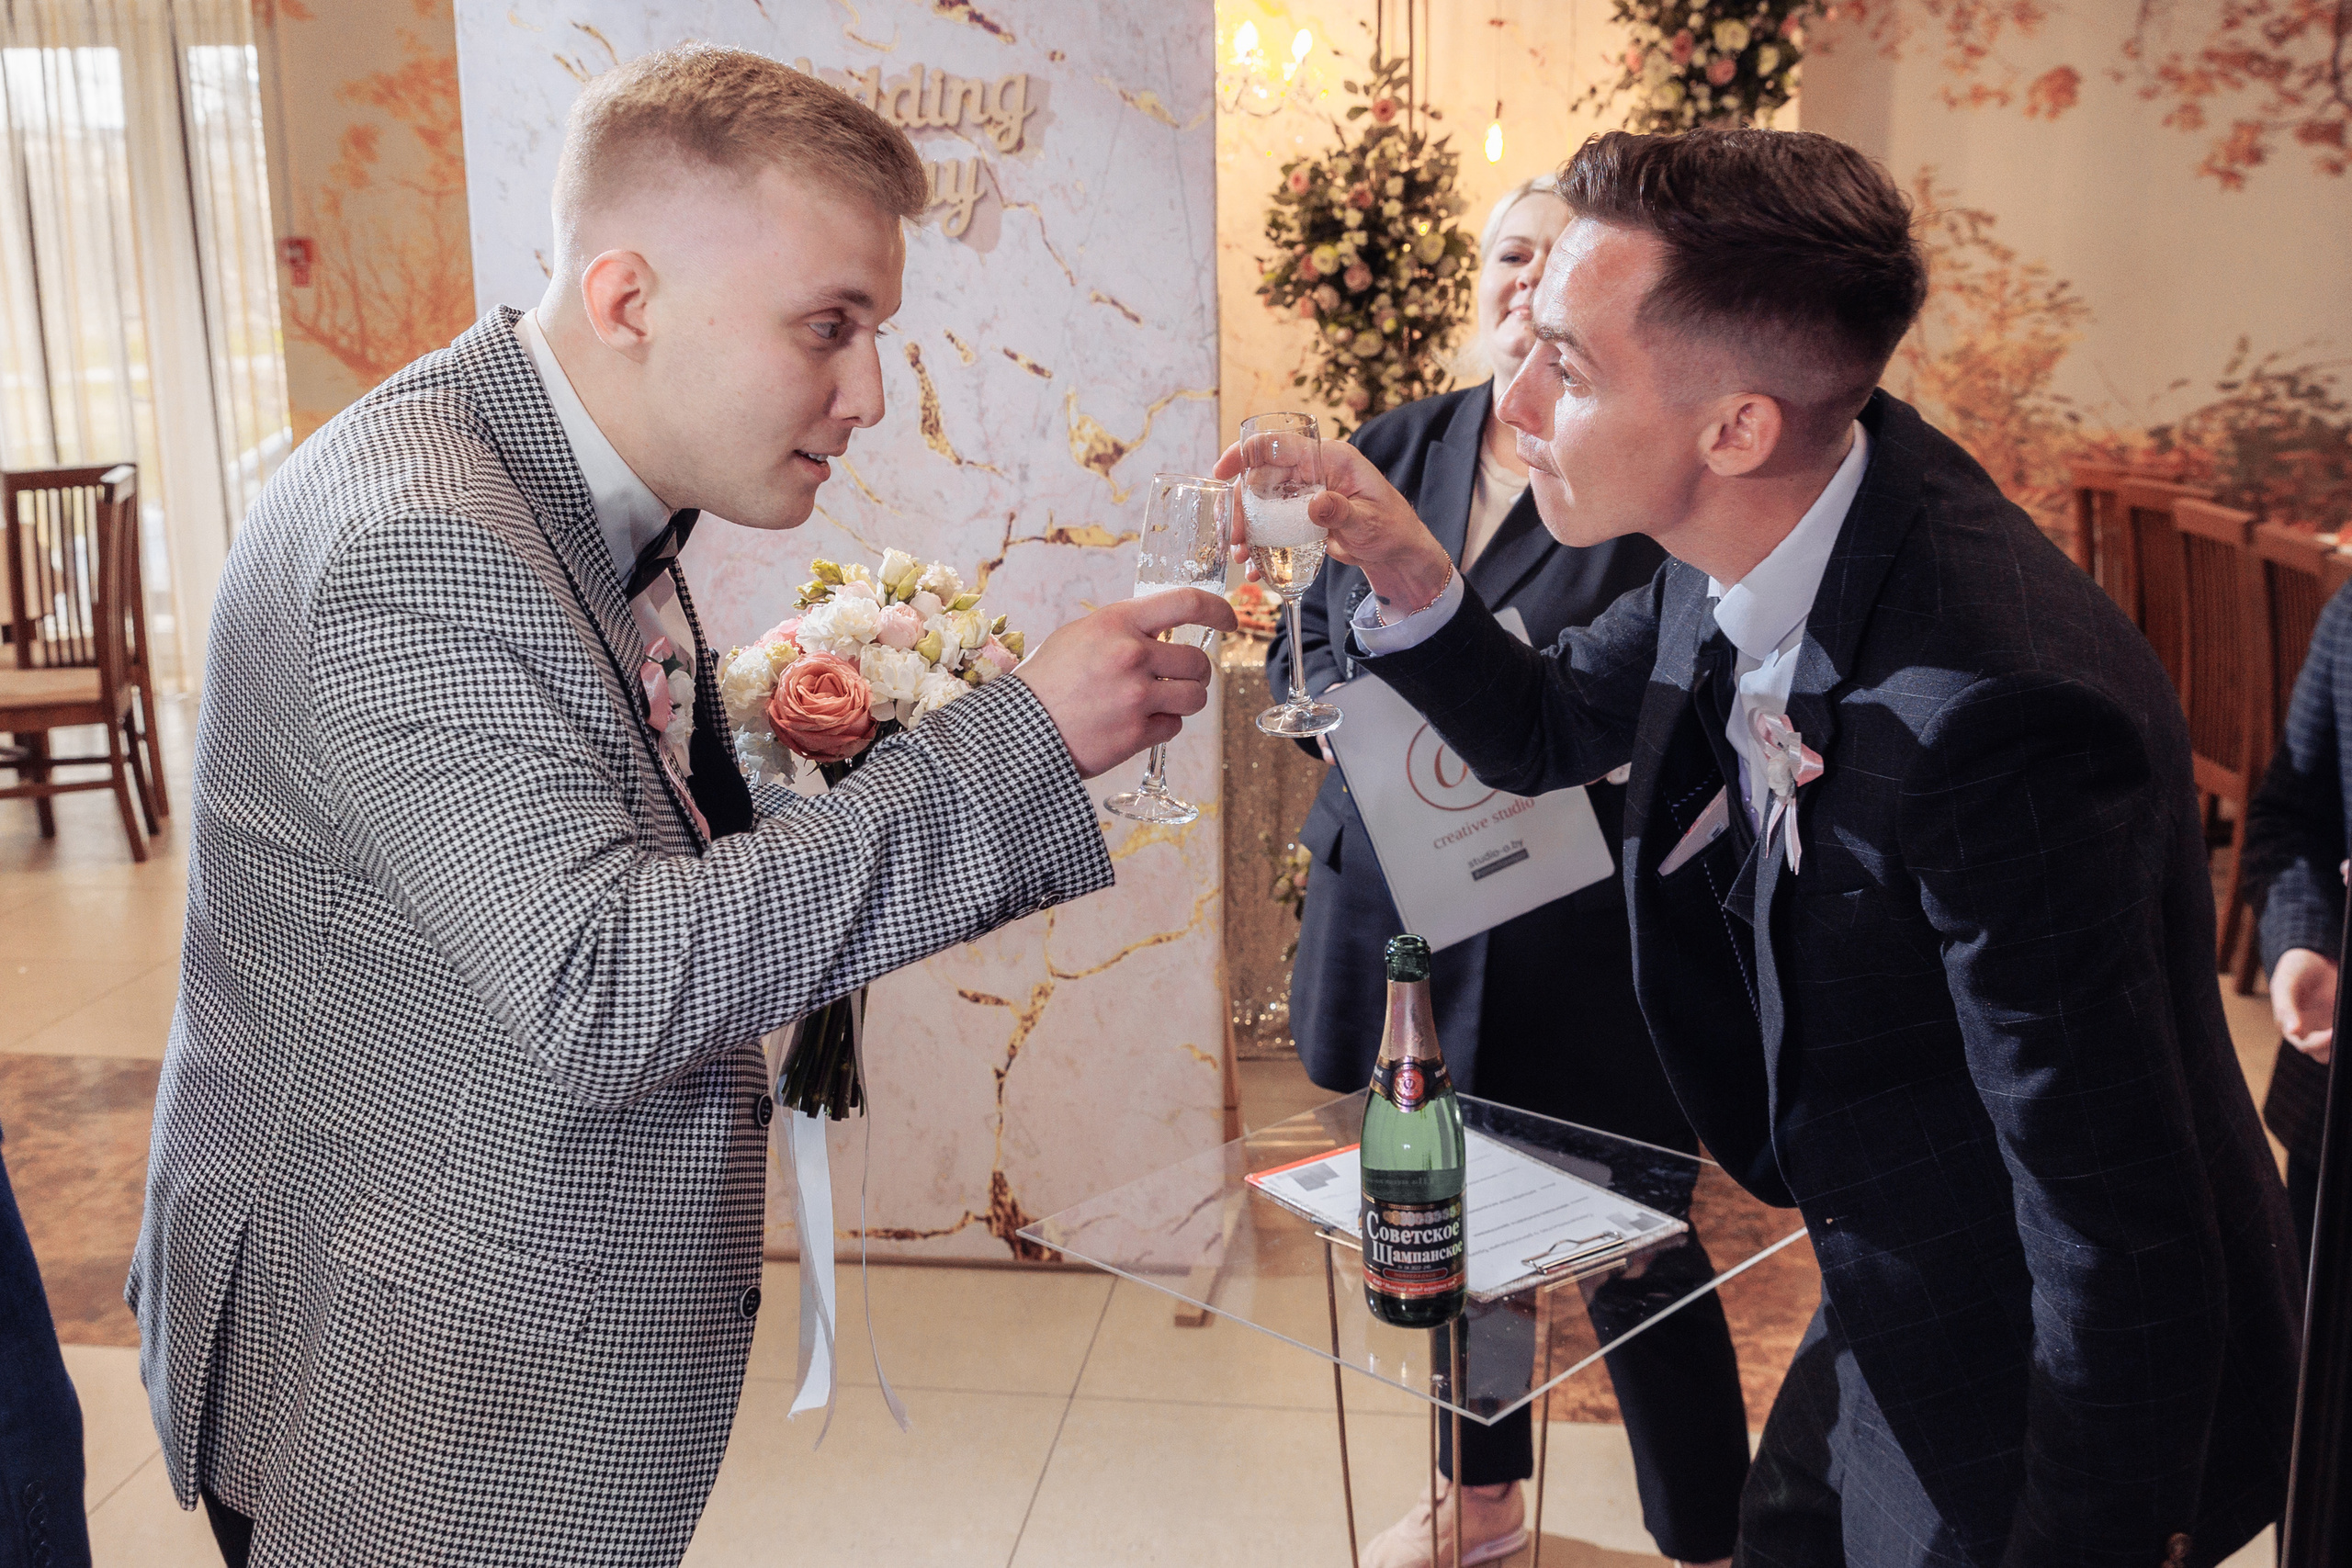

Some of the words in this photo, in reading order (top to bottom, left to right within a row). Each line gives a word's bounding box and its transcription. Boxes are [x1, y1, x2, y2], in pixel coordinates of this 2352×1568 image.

[797, 58, 1036, 153] dding
[1433, 818, 1488, 850] creative
[1491, 797, 1535, 823] studio
[1366, 1210, 1460, 1245] Советское
[1372, 1240, 1464, 1267] Шампанское
